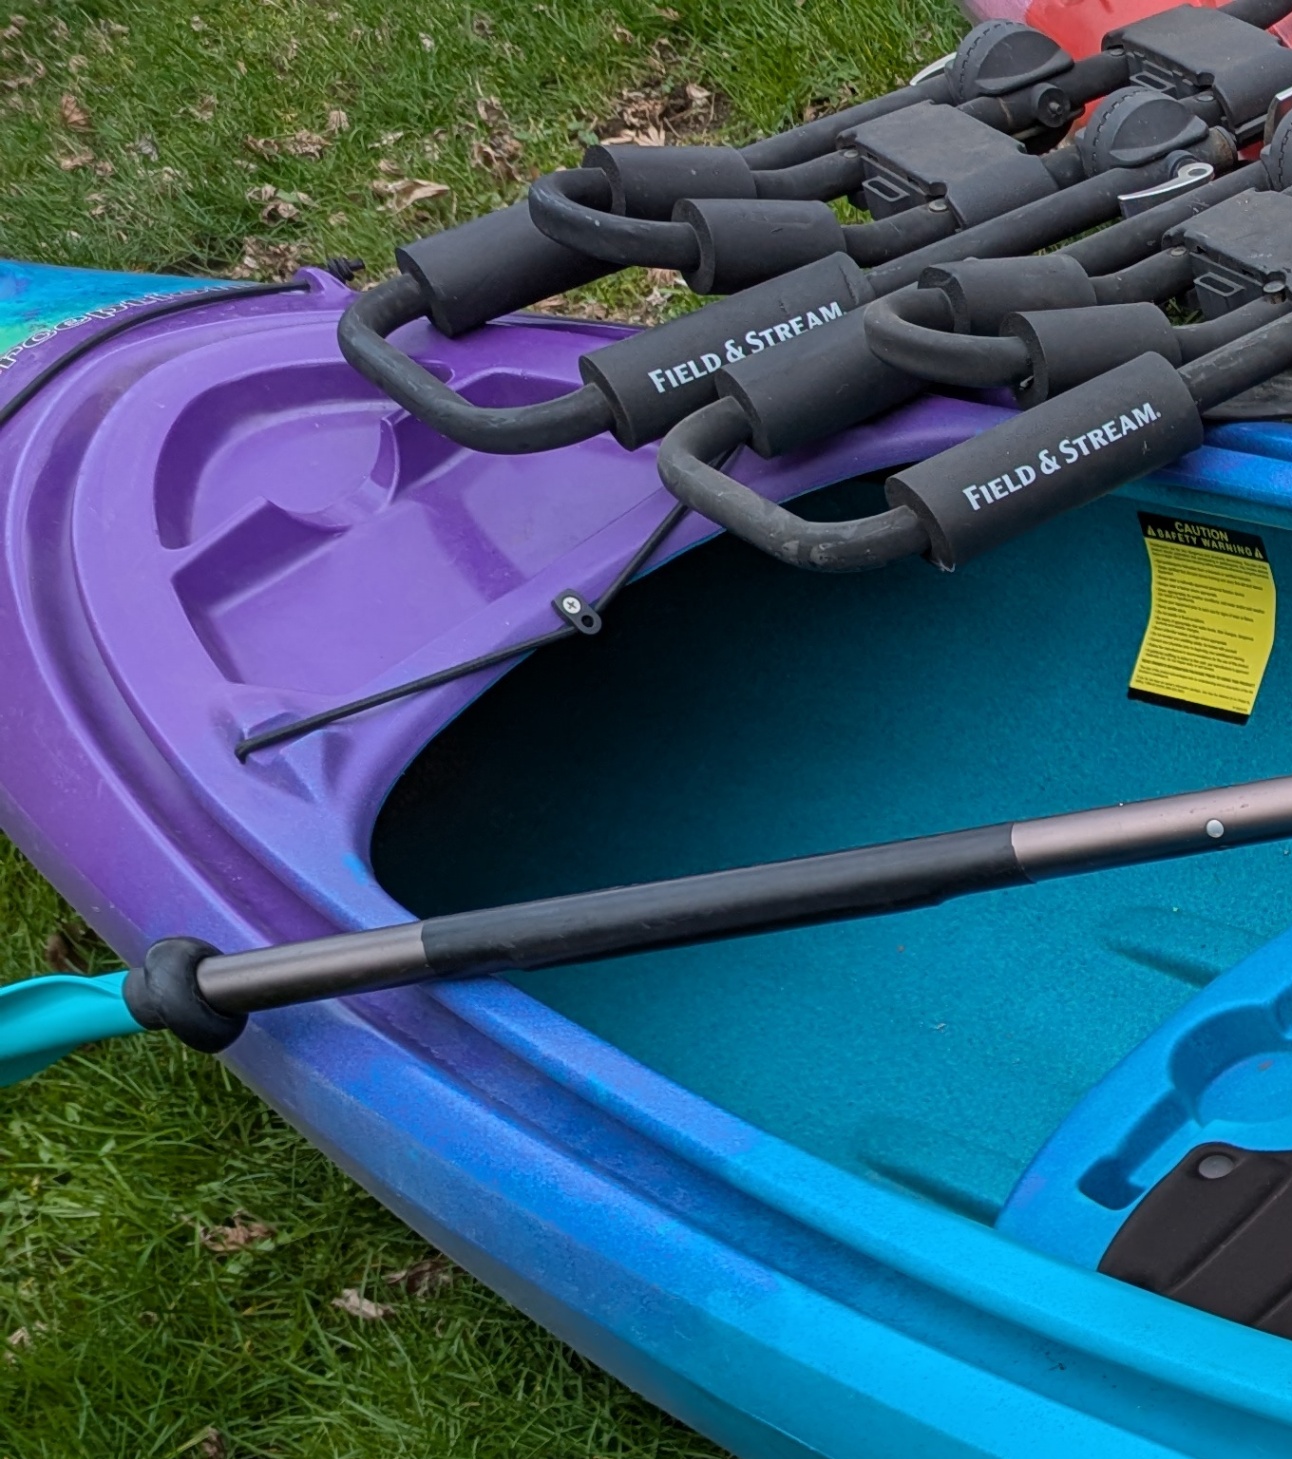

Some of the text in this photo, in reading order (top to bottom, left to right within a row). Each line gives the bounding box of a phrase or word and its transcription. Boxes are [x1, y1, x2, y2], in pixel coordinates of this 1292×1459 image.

[647, 352, 722, 394] FIELD
[724, 338, 746, 363] &
[962, 465, 1036, 511] FIELD
[1038, 449, 1062, 475] &
[1155, 528, 1253, 557] SAFETY WARNING
[1174, 521, 1230, 543] CAUTION
